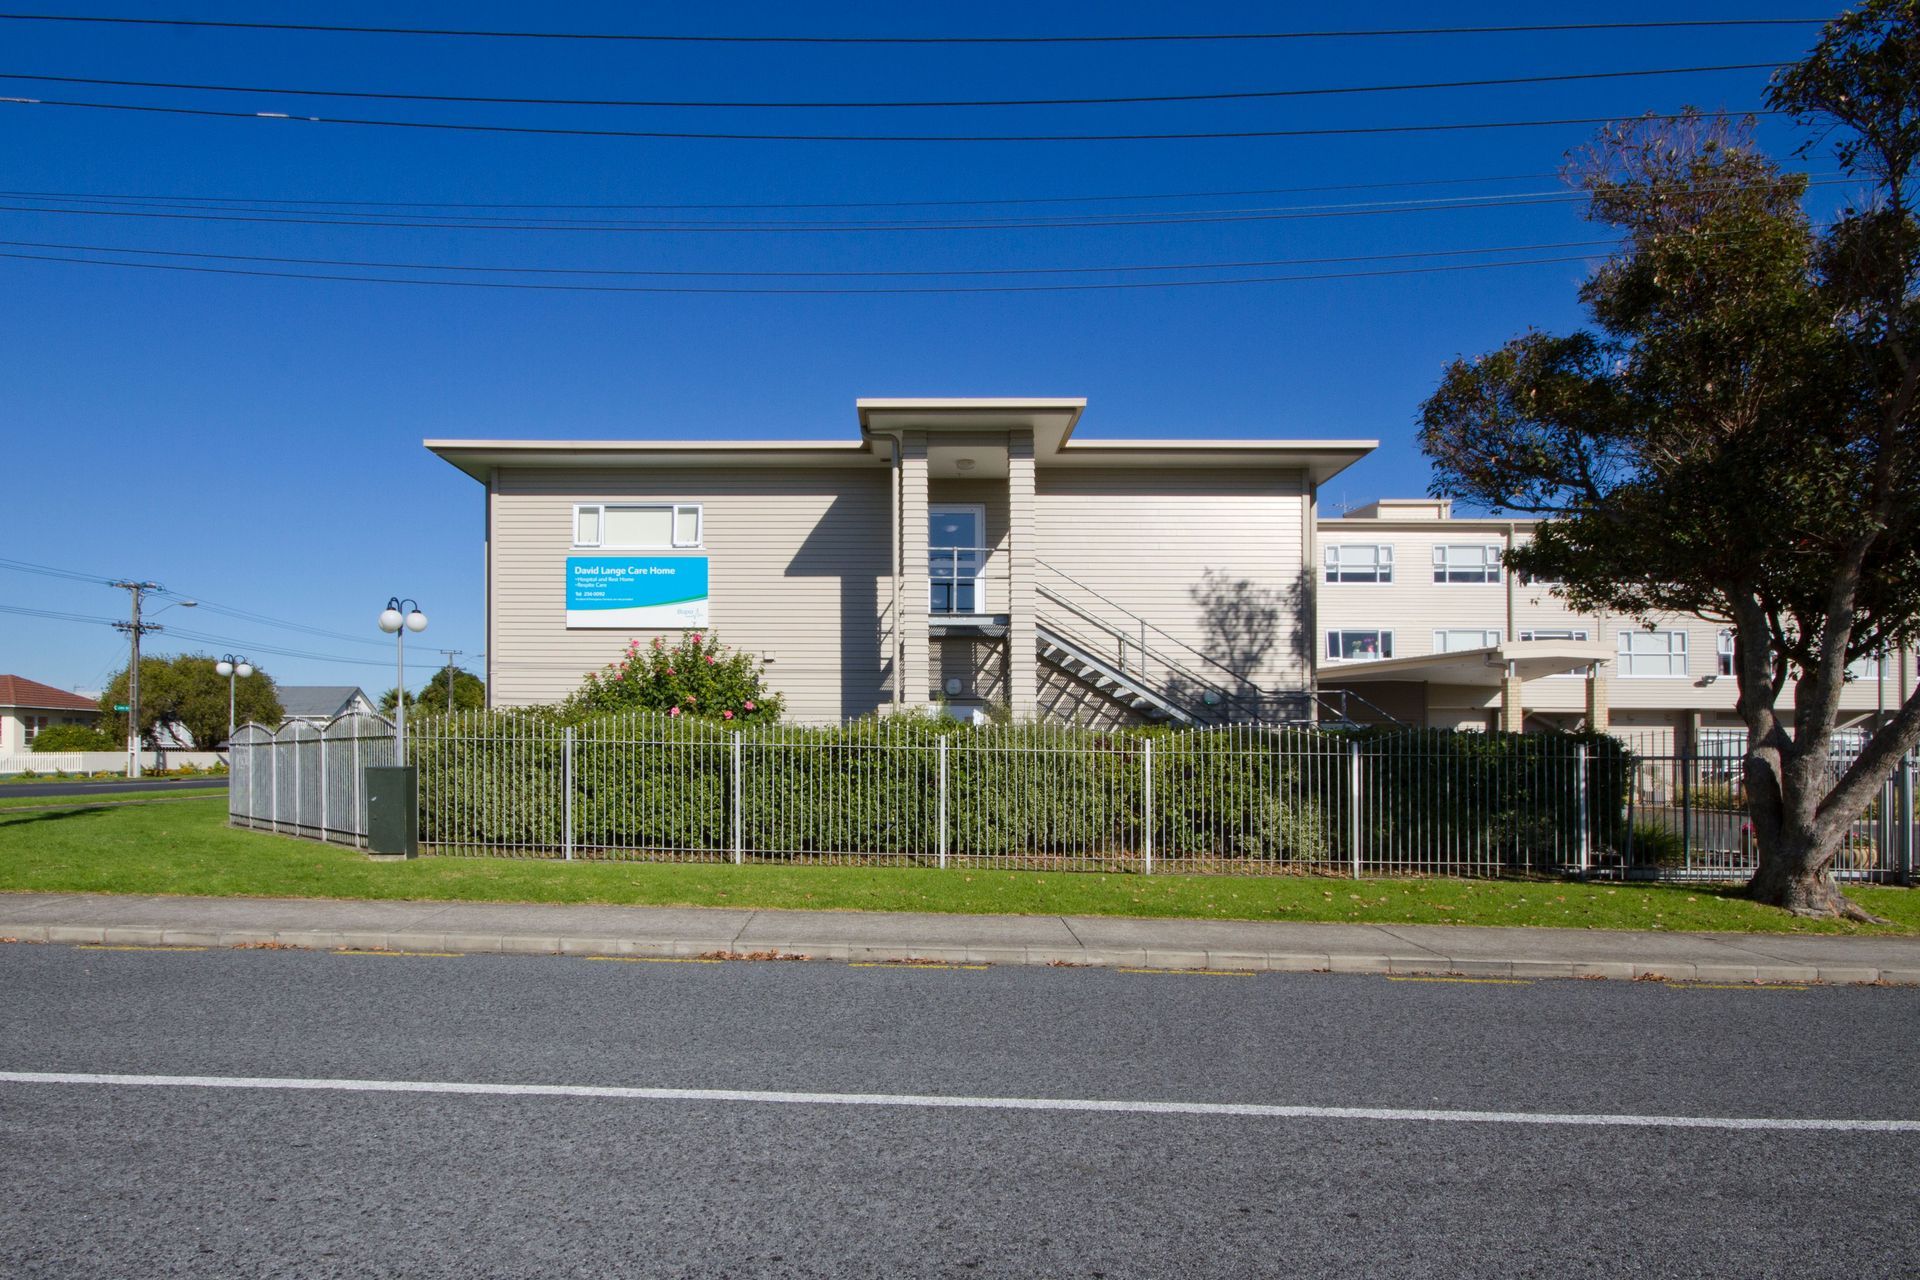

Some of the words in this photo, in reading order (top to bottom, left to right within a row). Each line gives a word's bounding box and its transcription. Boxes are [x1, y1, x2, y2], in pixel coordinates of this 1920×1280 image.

[574, 566, 599, 575] David
[601, 566, 626, 577] Lange
[628, 566, 648, 575] Care
[650, 566, 676, 575] Home
